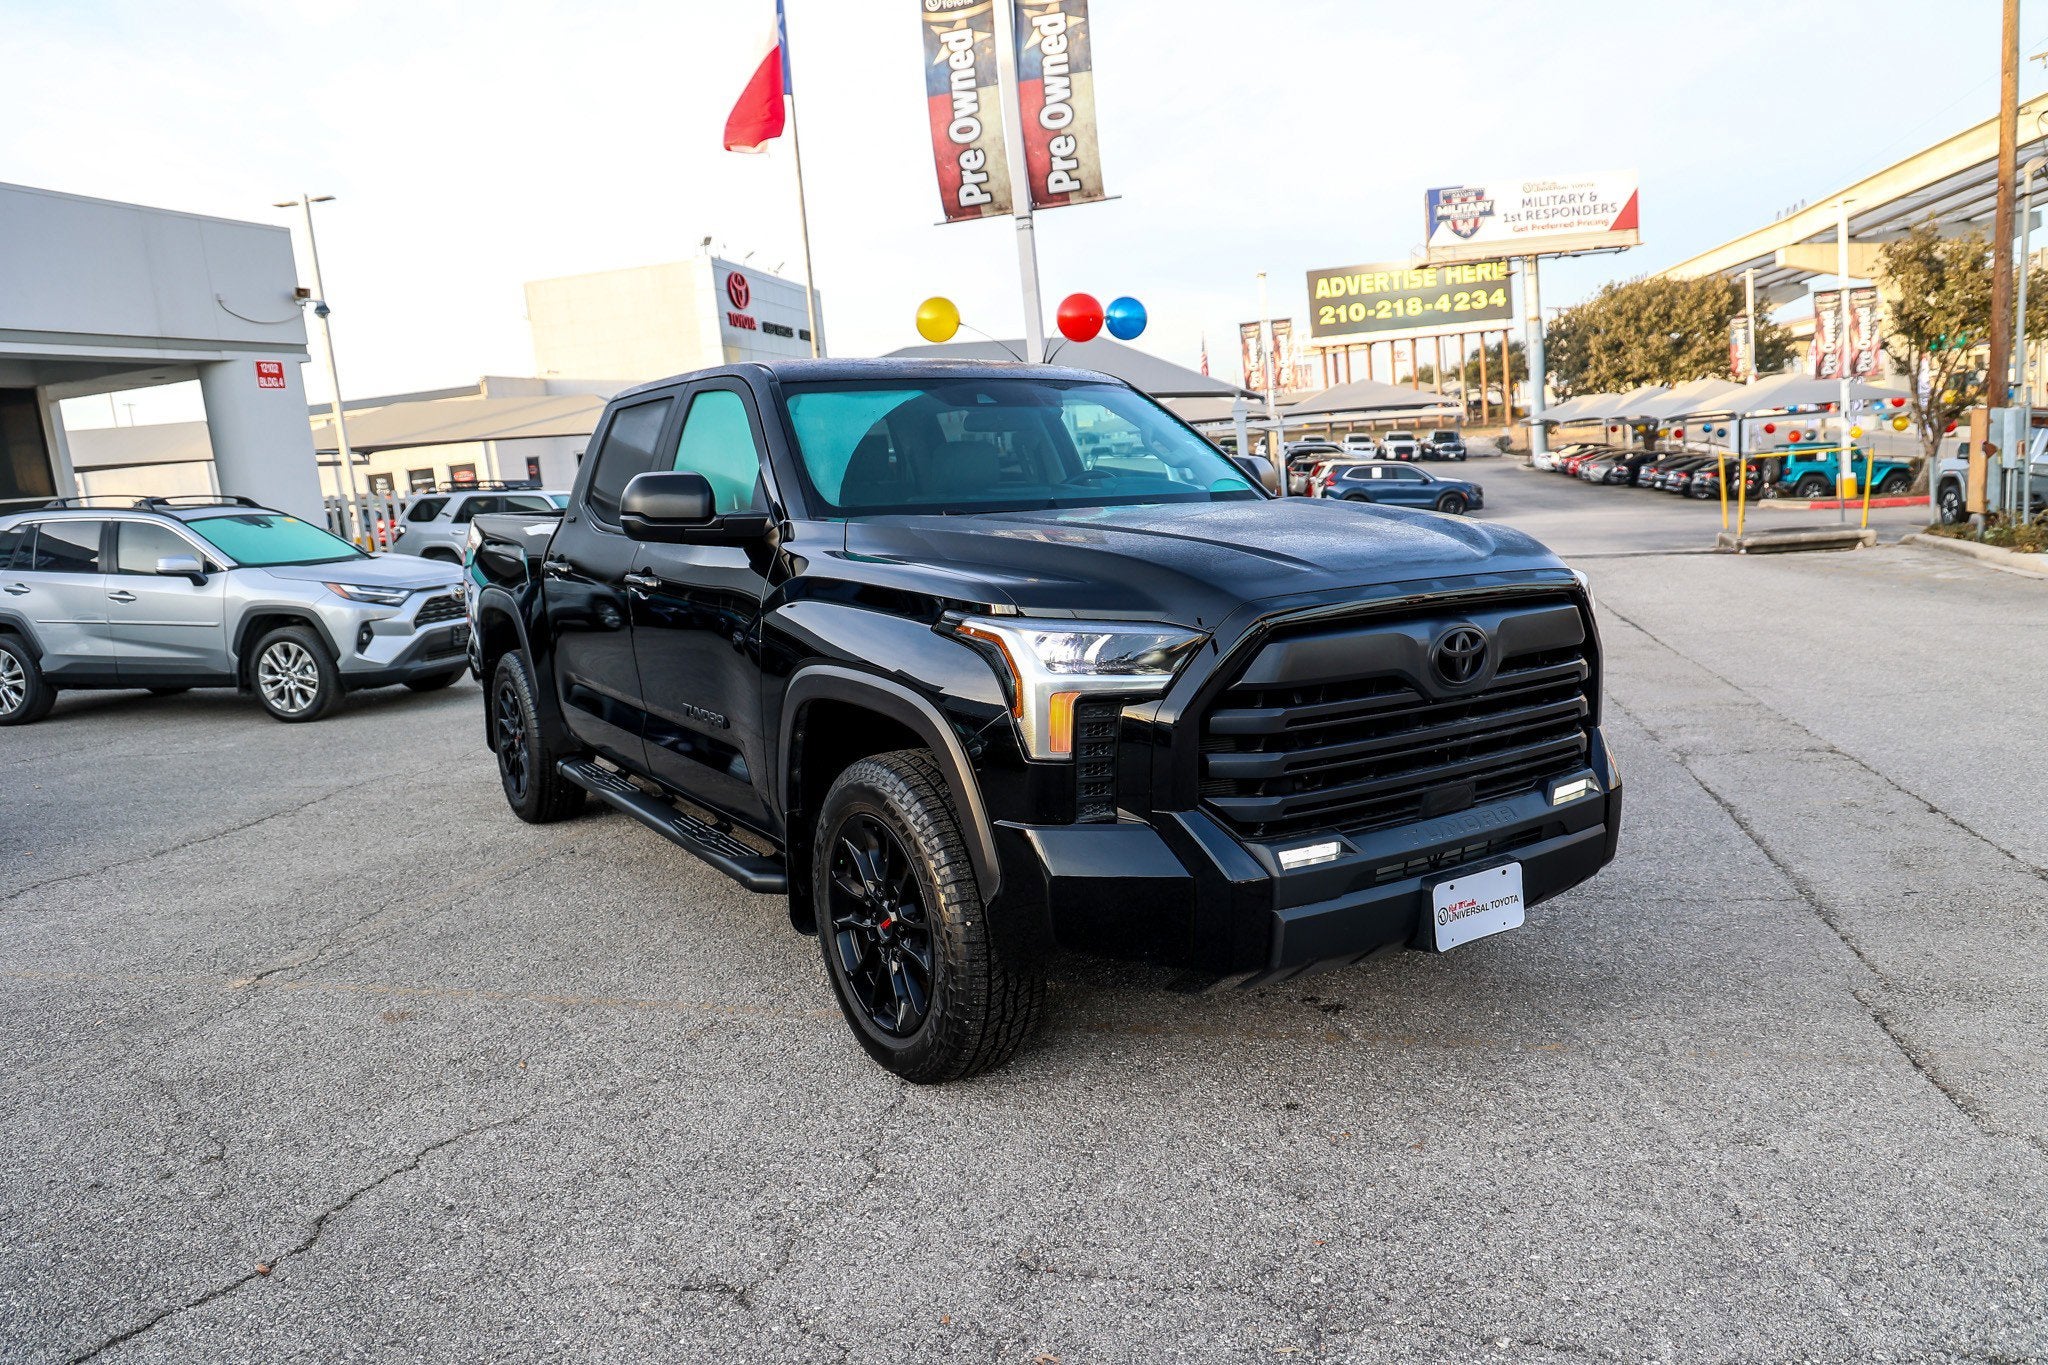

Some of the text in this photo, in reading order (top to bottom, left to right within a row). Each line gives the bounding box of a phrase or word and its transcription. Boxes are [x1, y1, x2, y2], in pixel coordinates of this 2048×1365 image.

[940, 28, 992, 207] Pre Owned
[1031, 12, 1082, 194] Pre Owned
[1436, 200, 1492, 217] MILITARY
[1503, 202, 1618, 223] 1st RESPONDERS
[1521, 191, 1598, 209] MILITARY &
[1315, 267, 1438, 300] ADVERTISE
[727, 311, 757, 331] TOYOTA
[1318, 287, 1507, 326] 210-218-4234
[682, 702, 730, 730] TUNDRA
[1402, 805, 1520, 846] TUNDRA
[1448, 894, 1519, 923] UNIVERSAL TOYOTA
